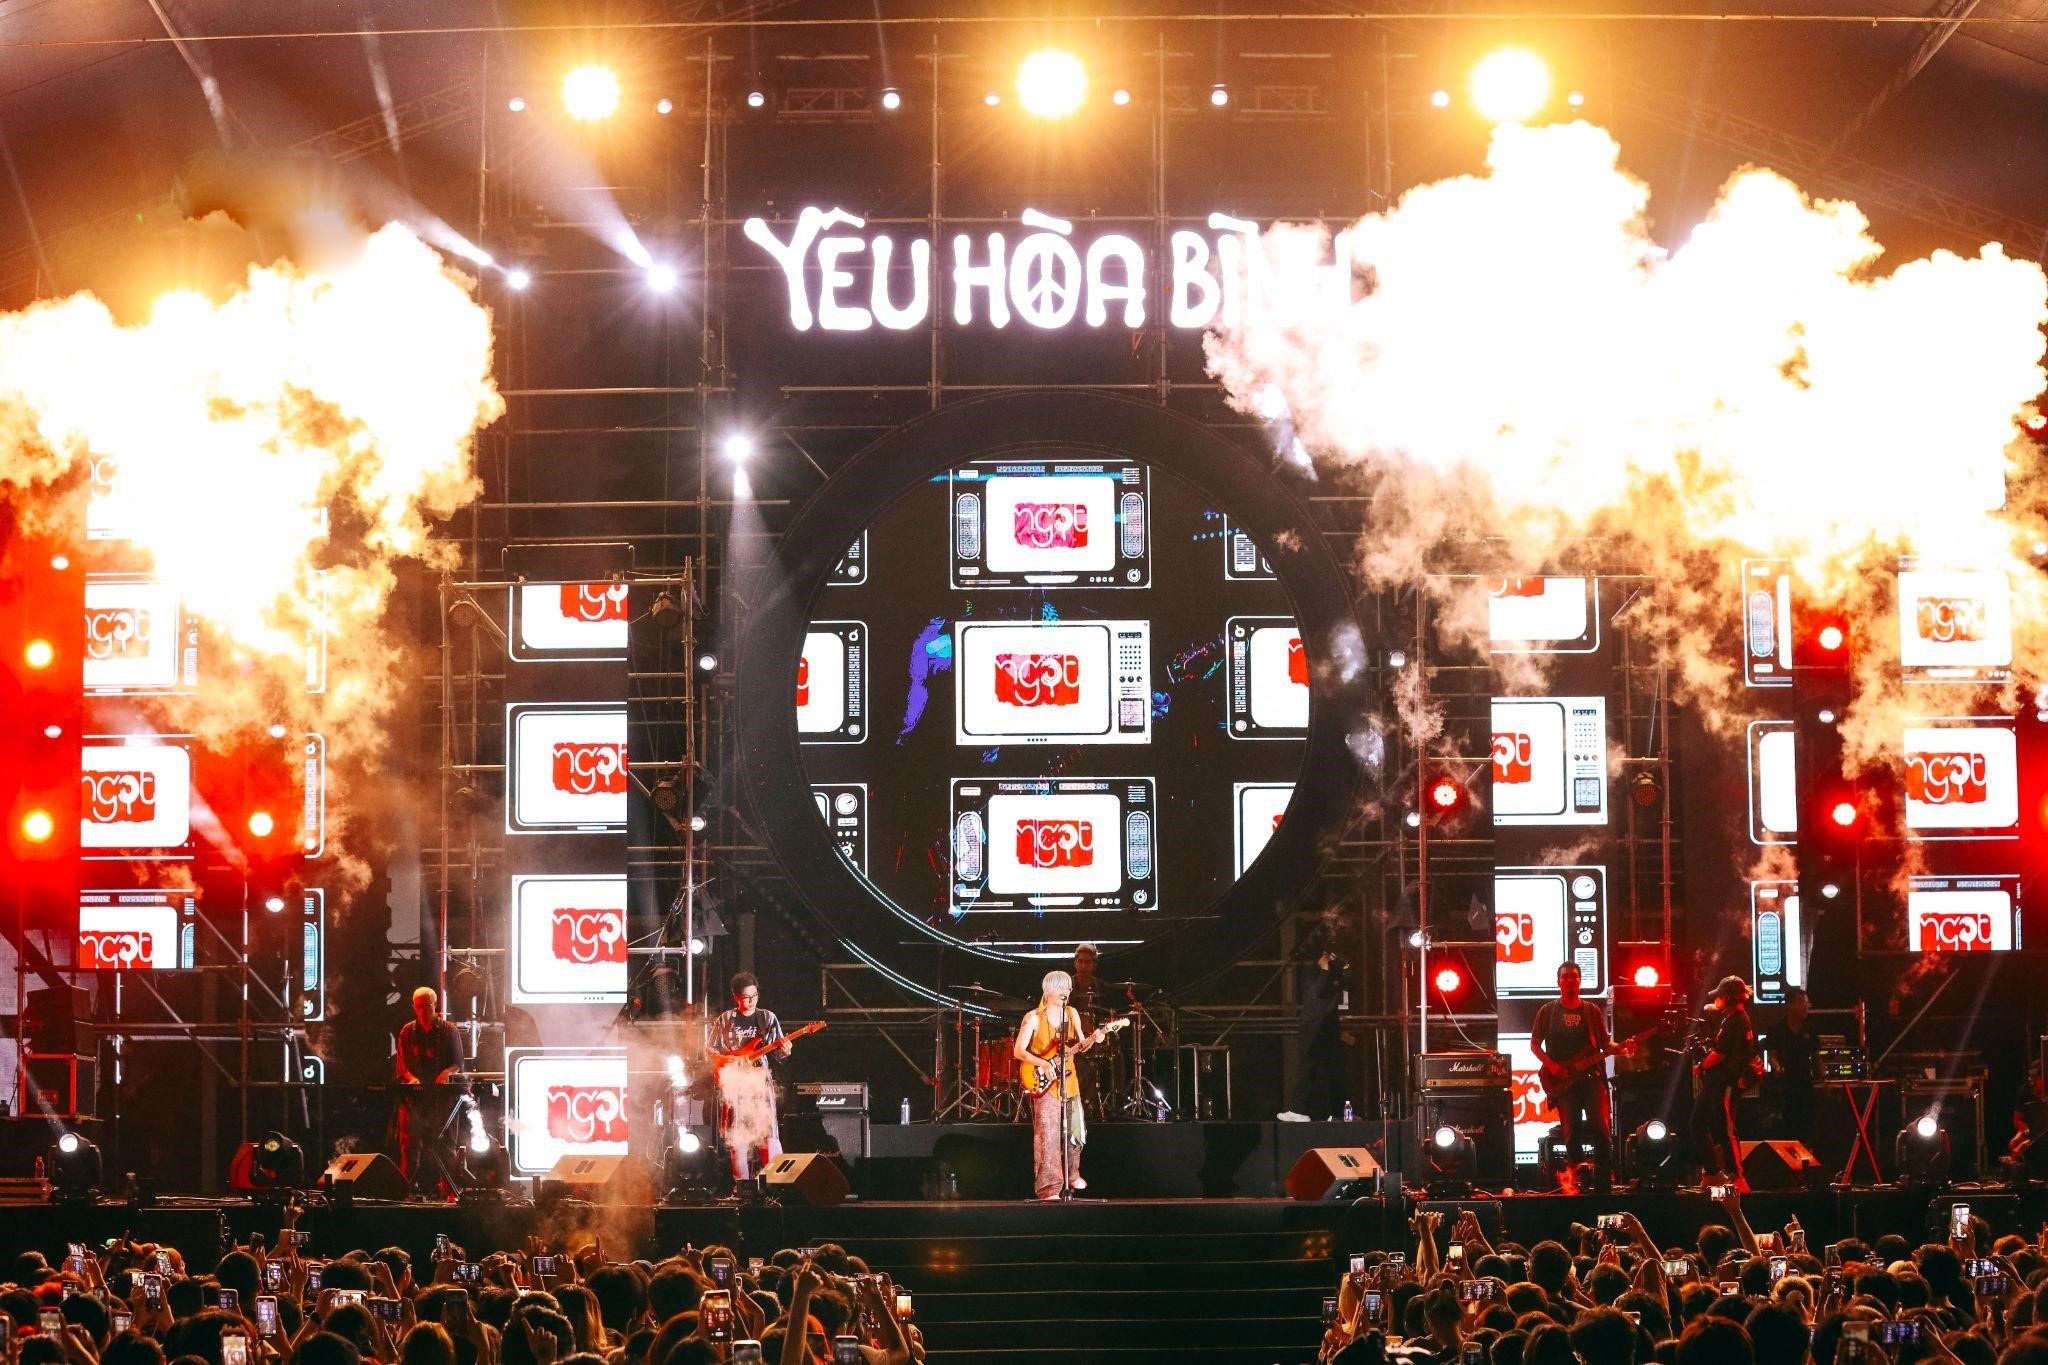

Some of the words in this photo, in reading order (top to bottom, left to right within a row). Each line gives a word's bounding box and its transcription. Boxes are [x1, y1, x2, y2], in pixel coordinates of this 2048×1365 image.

[744, 206, 930, 331] YÊU
[953, 208, 1146, 329] HÒA
[1449, 1061, 1485, 1072] Marshall
[816, 1096, 846, 1105] Marshall
